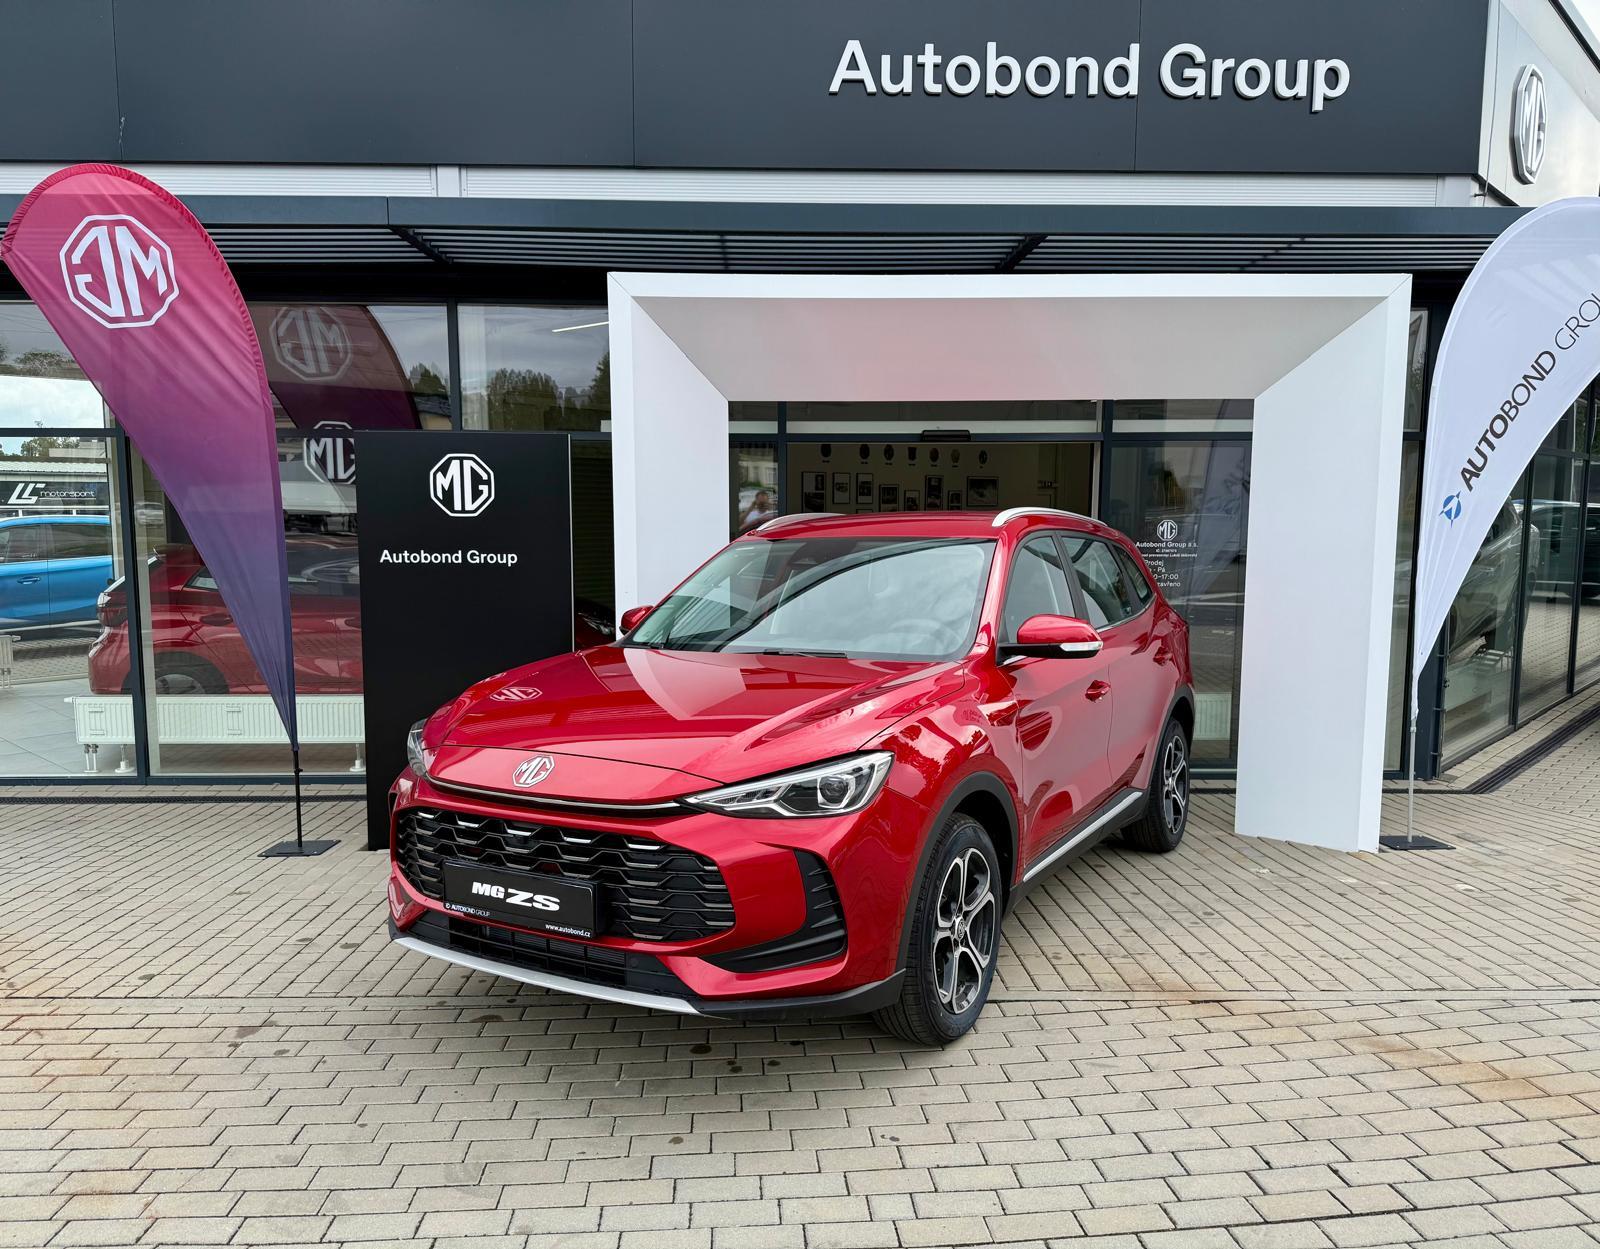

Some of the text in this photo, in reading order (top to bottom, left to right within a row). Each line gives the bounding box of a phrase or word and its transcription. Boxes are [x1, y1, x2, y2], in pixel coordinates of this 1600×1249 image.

[828, 38, 1351, 114] Autobond Group
[1459, 292, 1600, 492] AUTOBOND GRO
[40, 489, 95, 498] motorsport
[434, 458, 490, 512] MG
[1158, 521, 1177, 540] MG
[1167, 541, 1187, 549] Group
[379, 549, 518, 567] Autobond Group
[514, 755, 553, 785] MG
[471, 881, 560, 911] MG ZS
[545, 923, 591, 938] www.autobond.cz
